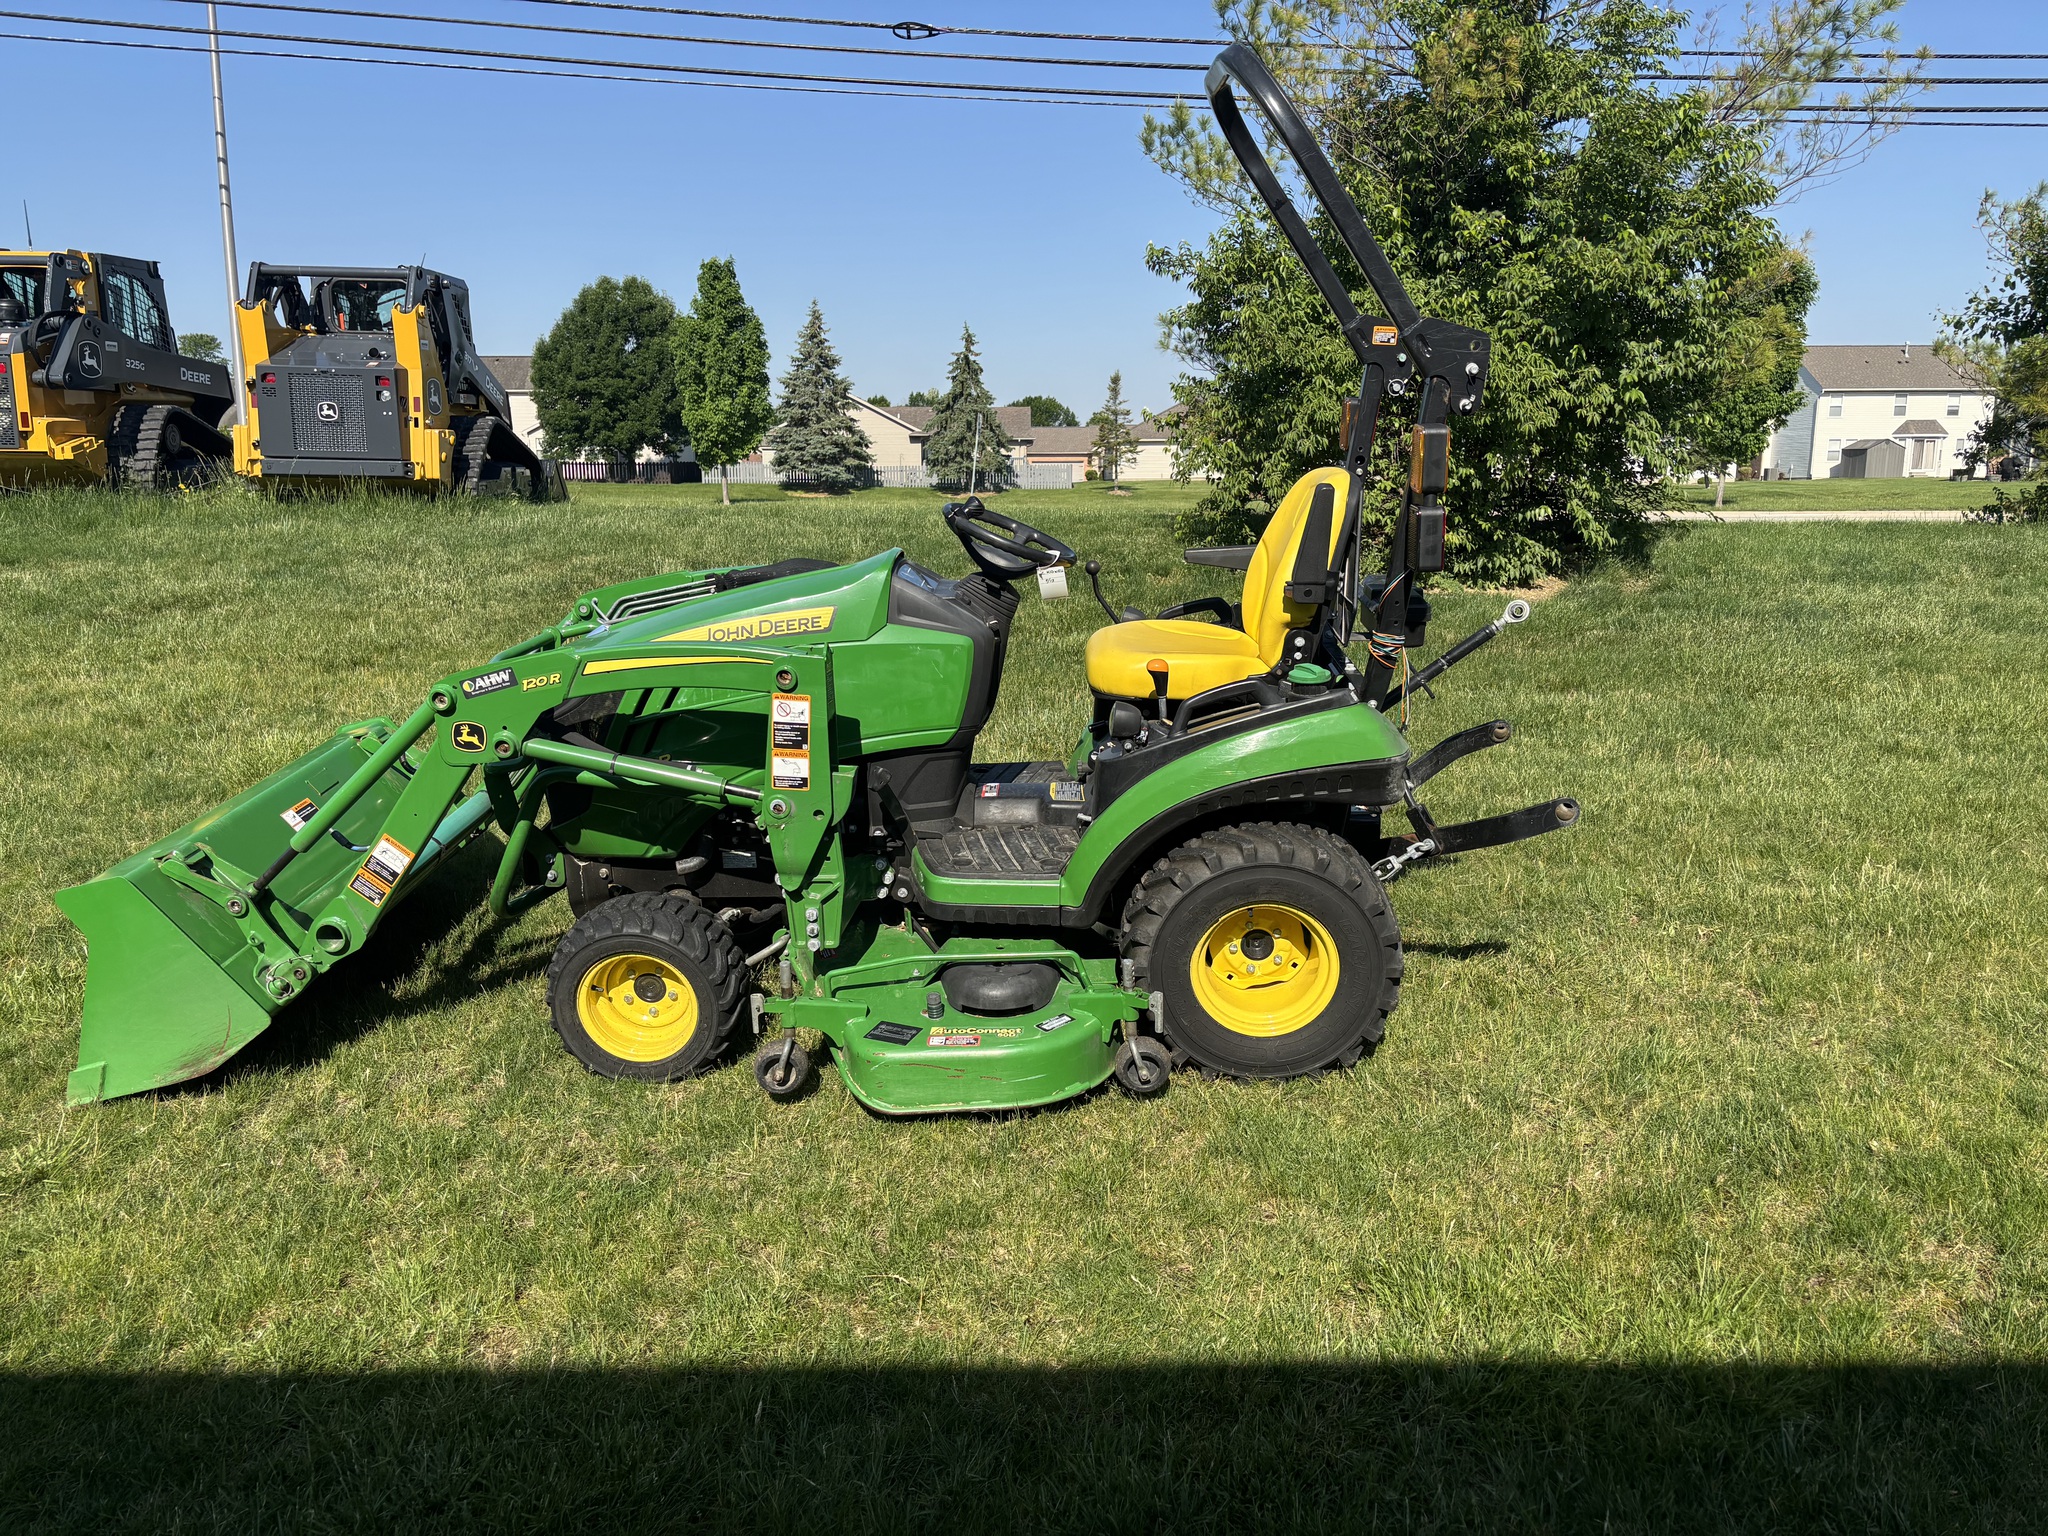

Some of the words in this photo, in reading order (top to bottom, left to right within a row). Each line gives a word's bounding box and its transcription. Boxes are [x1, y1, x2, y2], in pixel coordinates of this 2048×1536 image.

[125, 358, 145, 371] 325G
[180, 367, 212, 385] DEERE
[485, 374, 504, 407] DEERE
[707, 624, 754, 641] JOHN
[758, 616, 822, 635] DEERE
[475, 669, 511, 690] AHW
[930, 1026, 1022, 1036] AutoConnect
